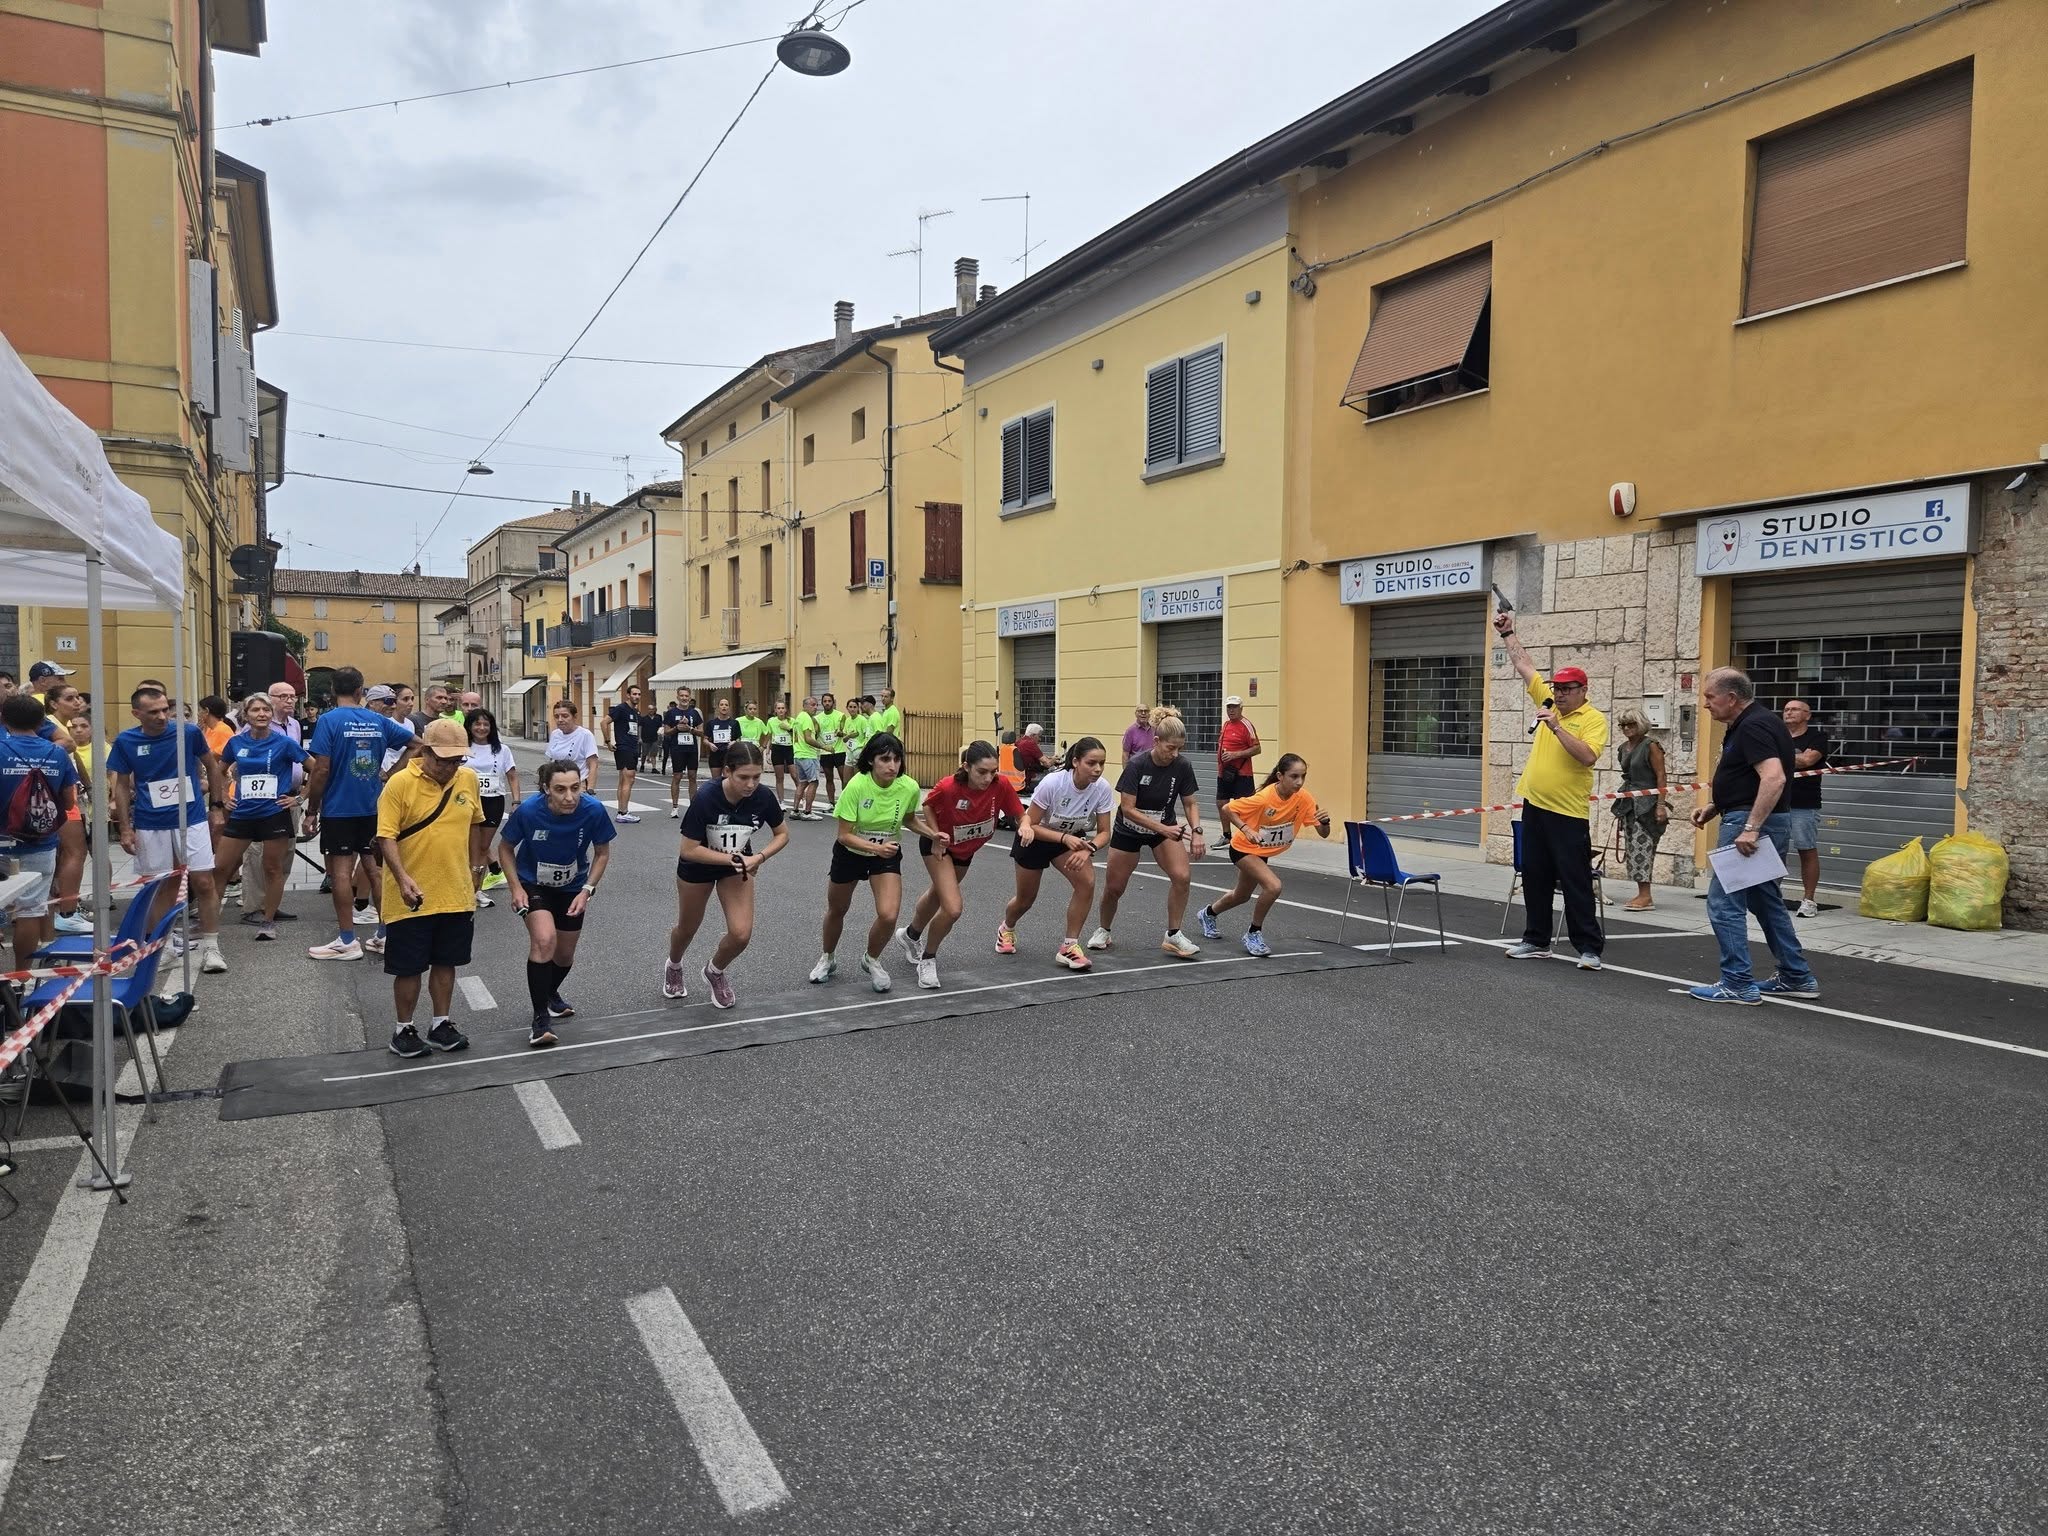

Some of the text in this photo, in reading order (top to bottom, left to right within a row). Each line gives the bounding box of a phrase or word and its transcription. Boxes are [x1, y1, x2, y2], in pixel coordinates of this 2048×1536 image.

[1762, 507, 1871, 536] STUDIO
[1760, 524, 1944, 560] DENTISTICO
[873, 563, 881, 575] P
[1375, 558, 1432, 576] STUDIO
[1375, 571, 1470, 594] DENTISTICO
[1161, 589, 1200, 602] STUDIO
[1161, 599, 1223, 616] DENTISTICO
[1013, 609, 1039, 621] STUDIO
[1013, 618, 1054, 631] DENTISTICO
[61, 640, 72, 648] 12
[1494, 653, 1503, 661] 84
[251, 779, 266, 791] 87
[966, 826, 982, 836] 41
[1059, 821, 1075, 830] 51
[720, 833, 737, 848] 11
[1270, 830, 1283, 842] 71
[553, 870, 571, 881] 81
